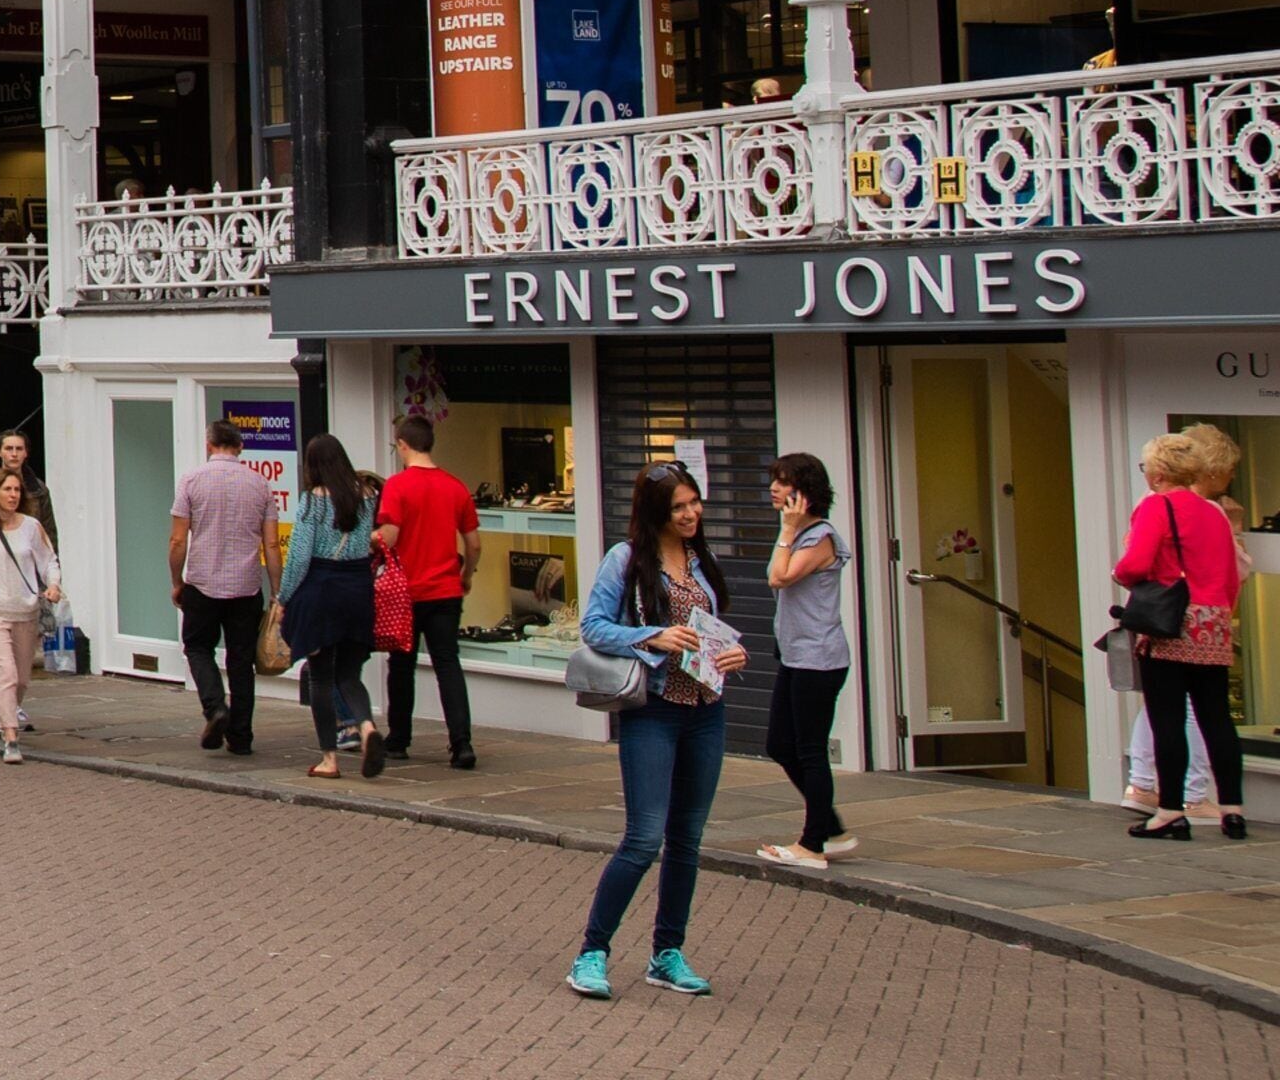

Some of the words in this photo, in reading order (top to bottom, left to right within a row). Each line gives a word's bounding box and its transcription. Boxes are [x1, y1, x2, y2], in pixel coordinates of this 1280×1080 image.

[440, 0, 453, 11] SEE
[437, 12, 506, 32] LEATHER
[573, 19, 594, 29] LAKE
[111, 24, 169, 41] Woollen
[173, 26, 203, 41] Mill
[574, 28, 599, 38] LAND
[444, 34, 498, 53] RANGE
[439, 55, 514, 75] UPSTAIRS
[546, 81, 555, 89] UP
[556, 81, 567, 89] TO
[464, 262, 737, 324] ERNEST
[794, 247, 1086, 318] JONES
